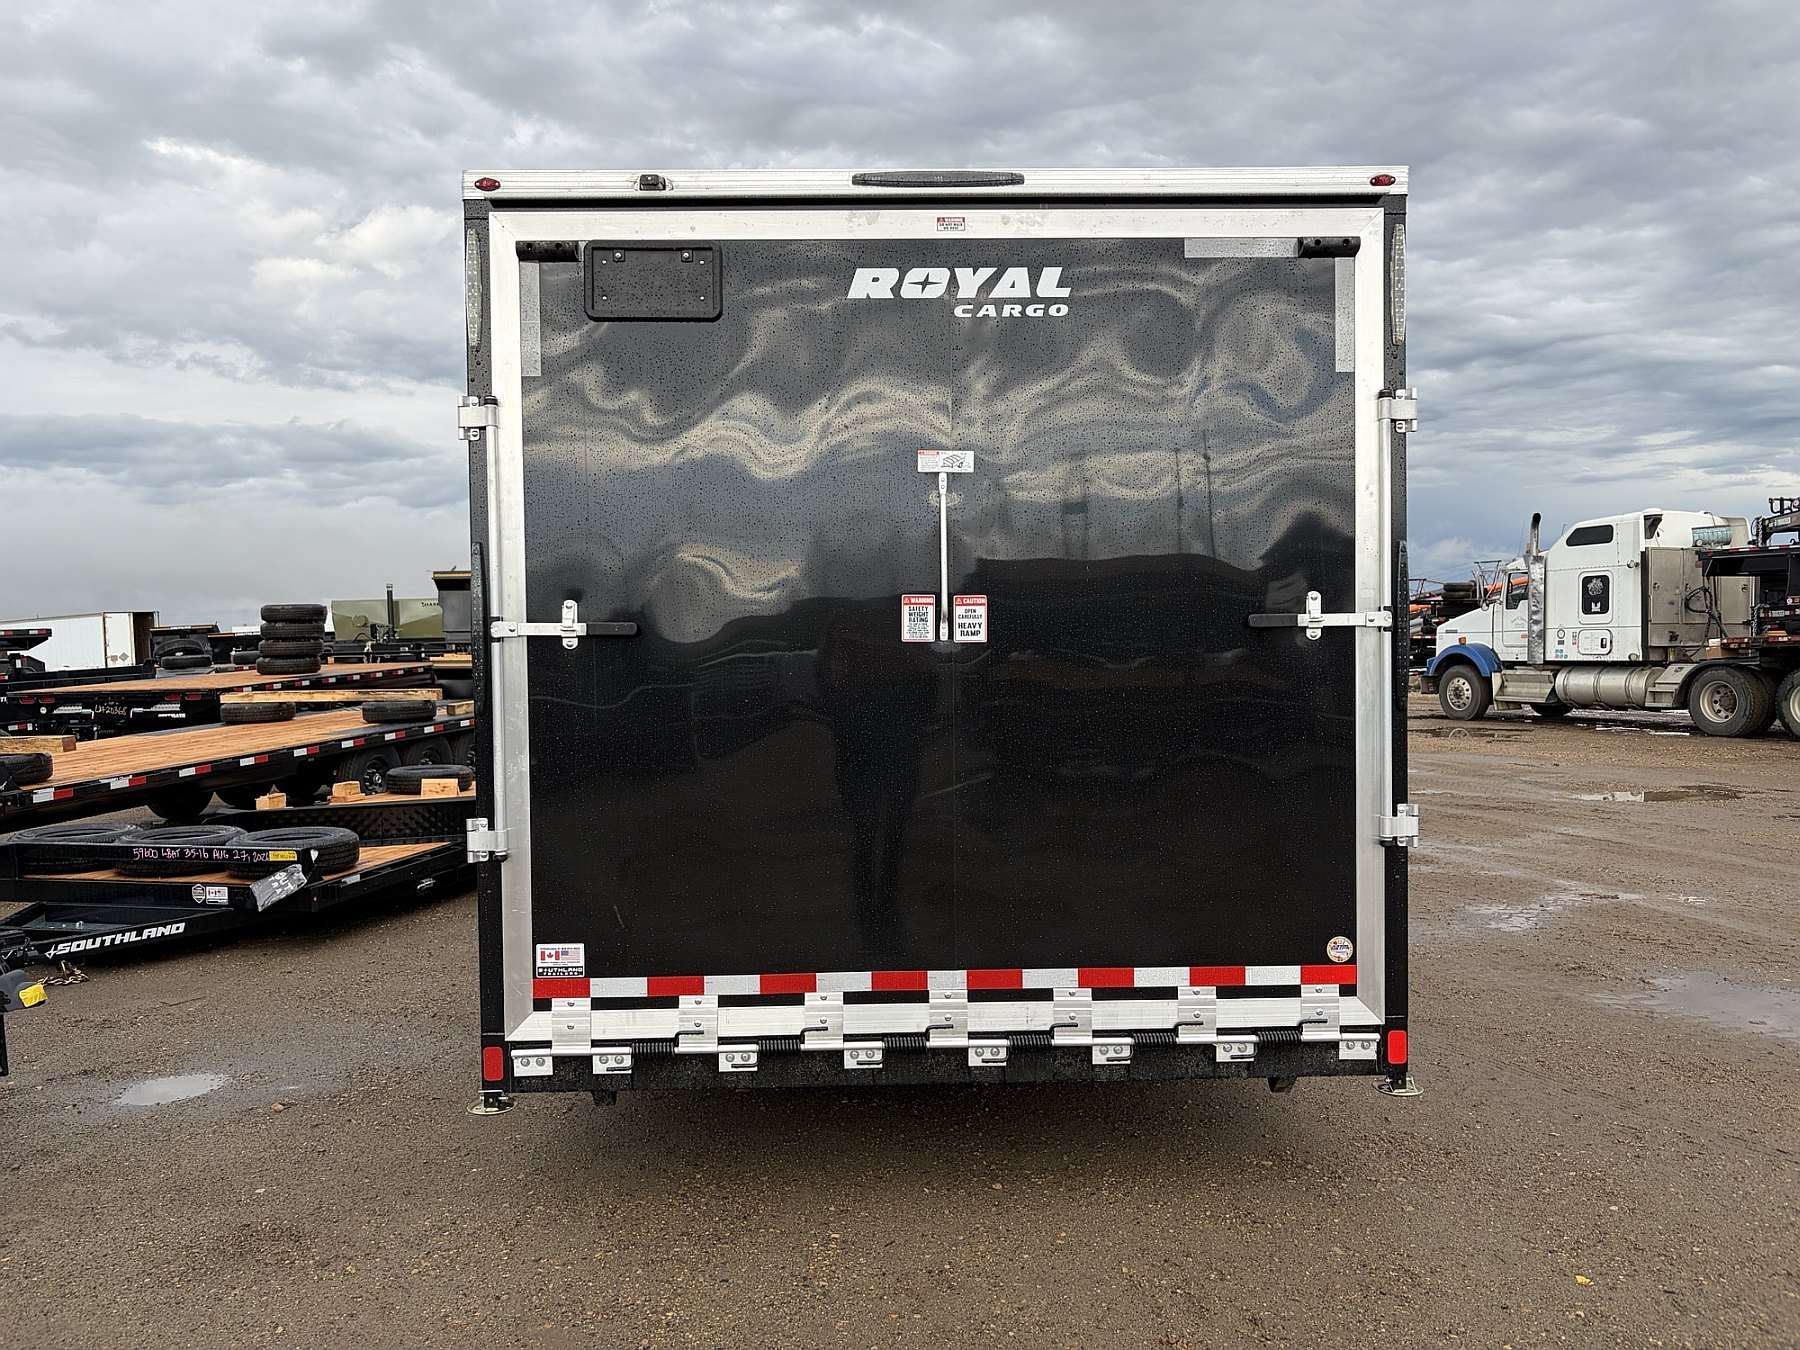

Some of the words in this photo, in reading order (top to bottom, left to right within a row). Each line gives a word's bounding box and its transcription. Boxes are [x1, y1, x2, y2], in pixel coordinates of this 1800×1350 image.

[847, 267, 1071, 299] ROYAL
[953, 304, 1069, 318] CARGO
[56, 922, 186, 955] SOUTHLAND
